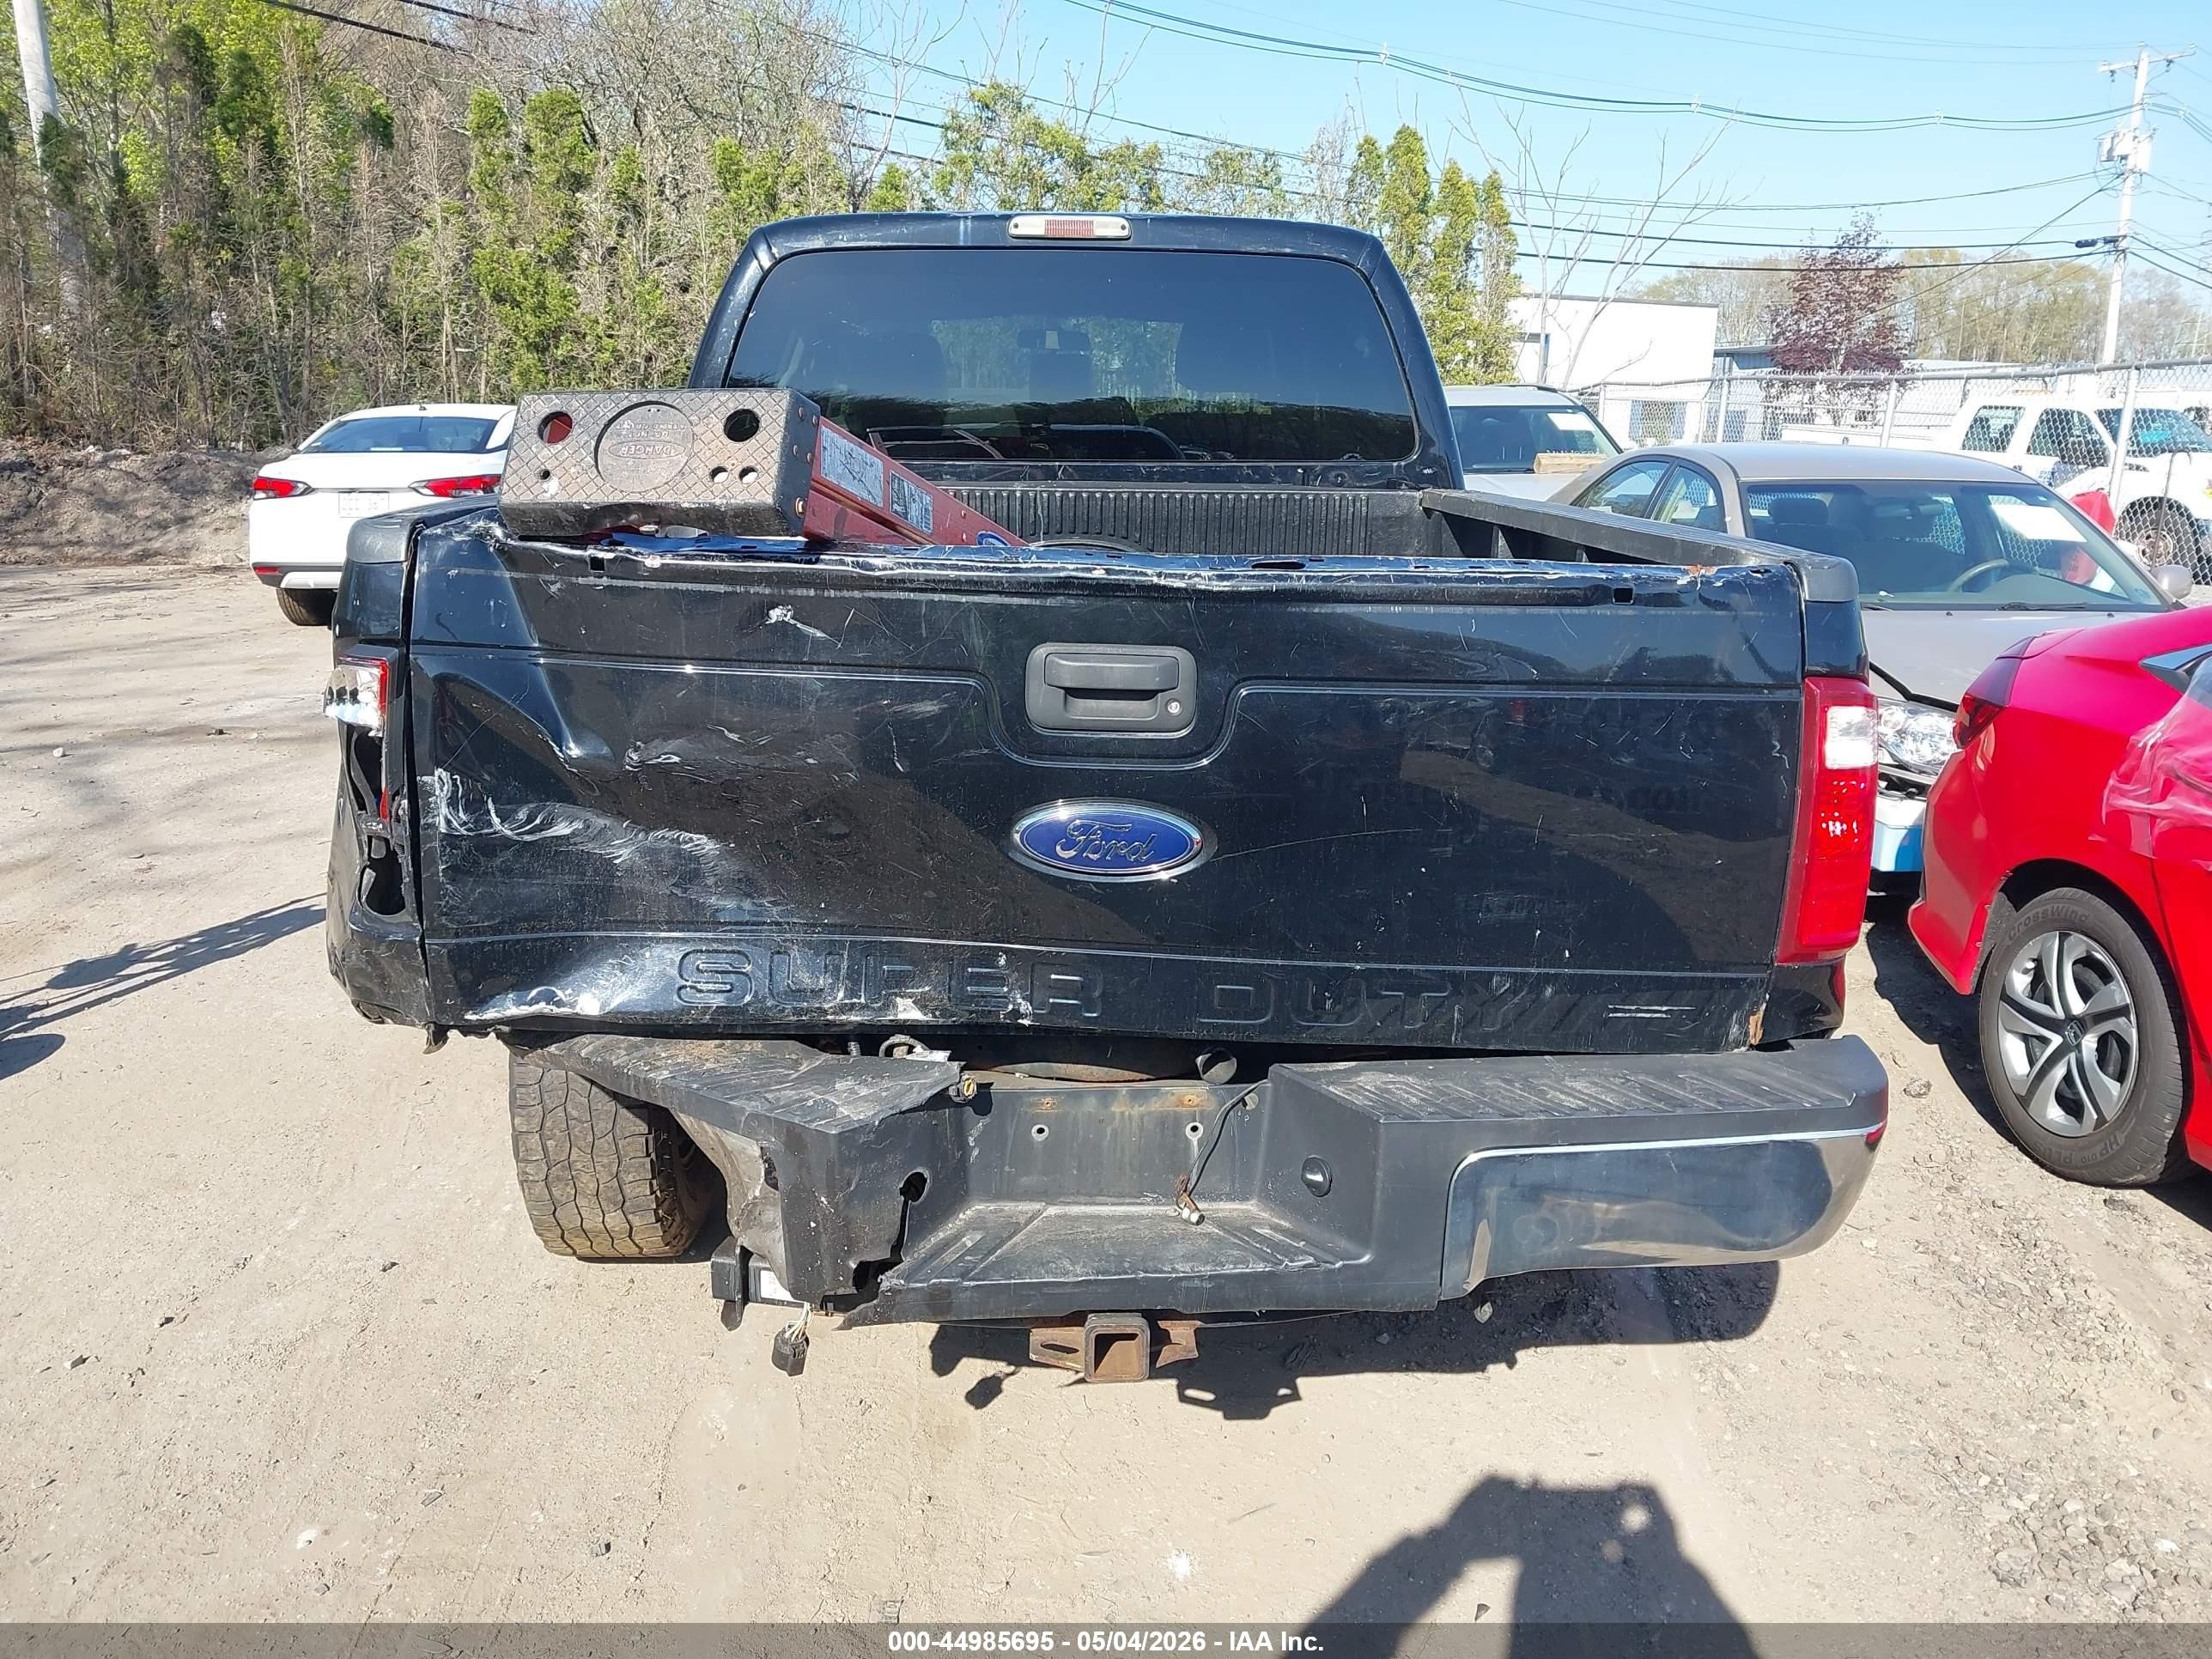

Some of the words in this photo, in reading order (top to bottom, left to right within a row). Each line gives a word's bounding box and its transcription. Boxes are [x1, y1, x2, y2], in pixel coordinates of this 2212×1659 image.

[619, 445, 672, 456] DANGER
[1055, 819, 1158, 861] Ford
[2008, 904, 2088, 941] CrossWind
[676, 947, 1103, 1018] SUPER
[1194, 974, 1535, 1030] DUTY
[2100, 1133, 2122, 1157] HP
